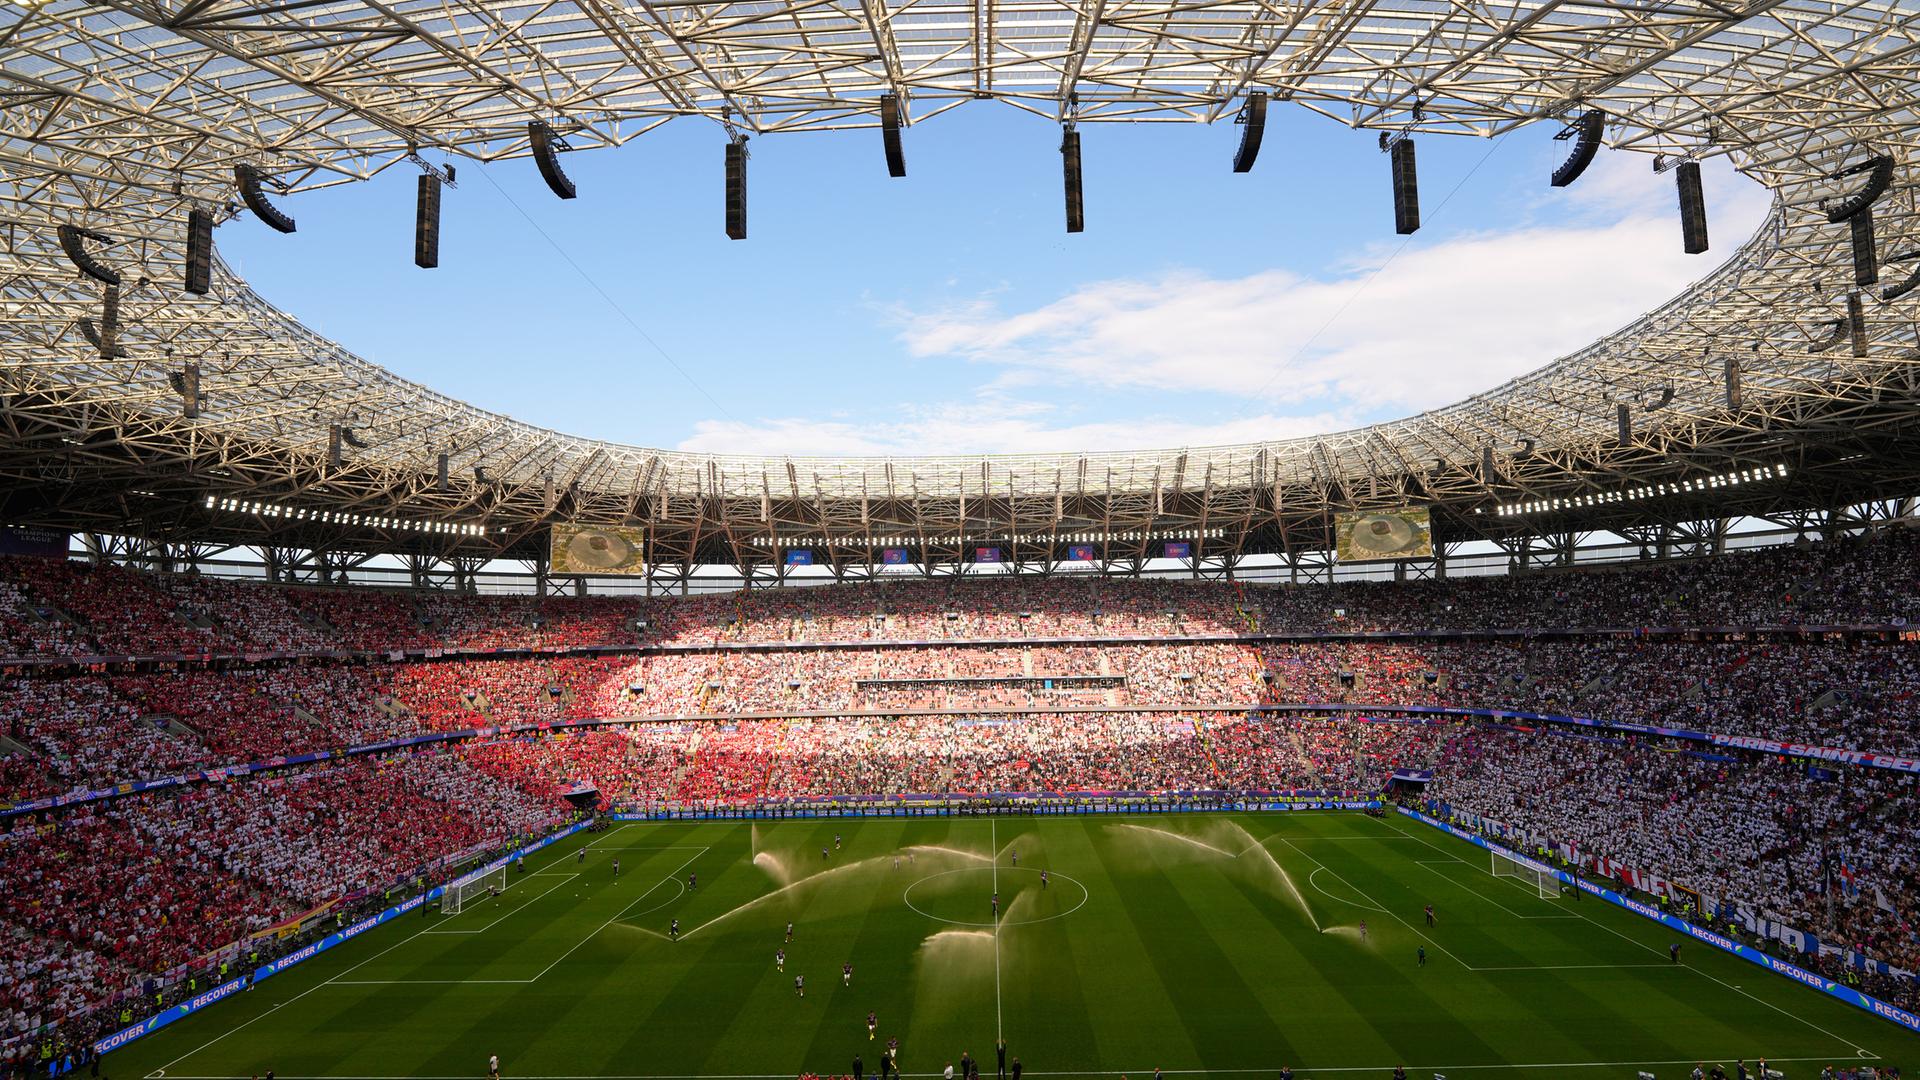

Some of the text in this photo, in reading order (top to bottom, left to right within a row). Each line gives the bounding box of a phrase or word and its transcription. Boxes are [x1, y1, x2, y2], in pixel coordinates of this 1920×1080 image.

[1714, 735, 1783, 753] PARIS
[1787, 744, 1868, 763] SAINT
[1626, 899, 1659, 919] RECOVER
[345, 917, 377, 937] RECOVER
[1692, 926, 1733, 951] RECOVER
[277, 945, 315, 969] RECOVER
[1772, 959, 1823, 989] RECOVER
[192, 981, 239, 1009] RECOVER
[94, 1025, 145, 1053] ECOVER
